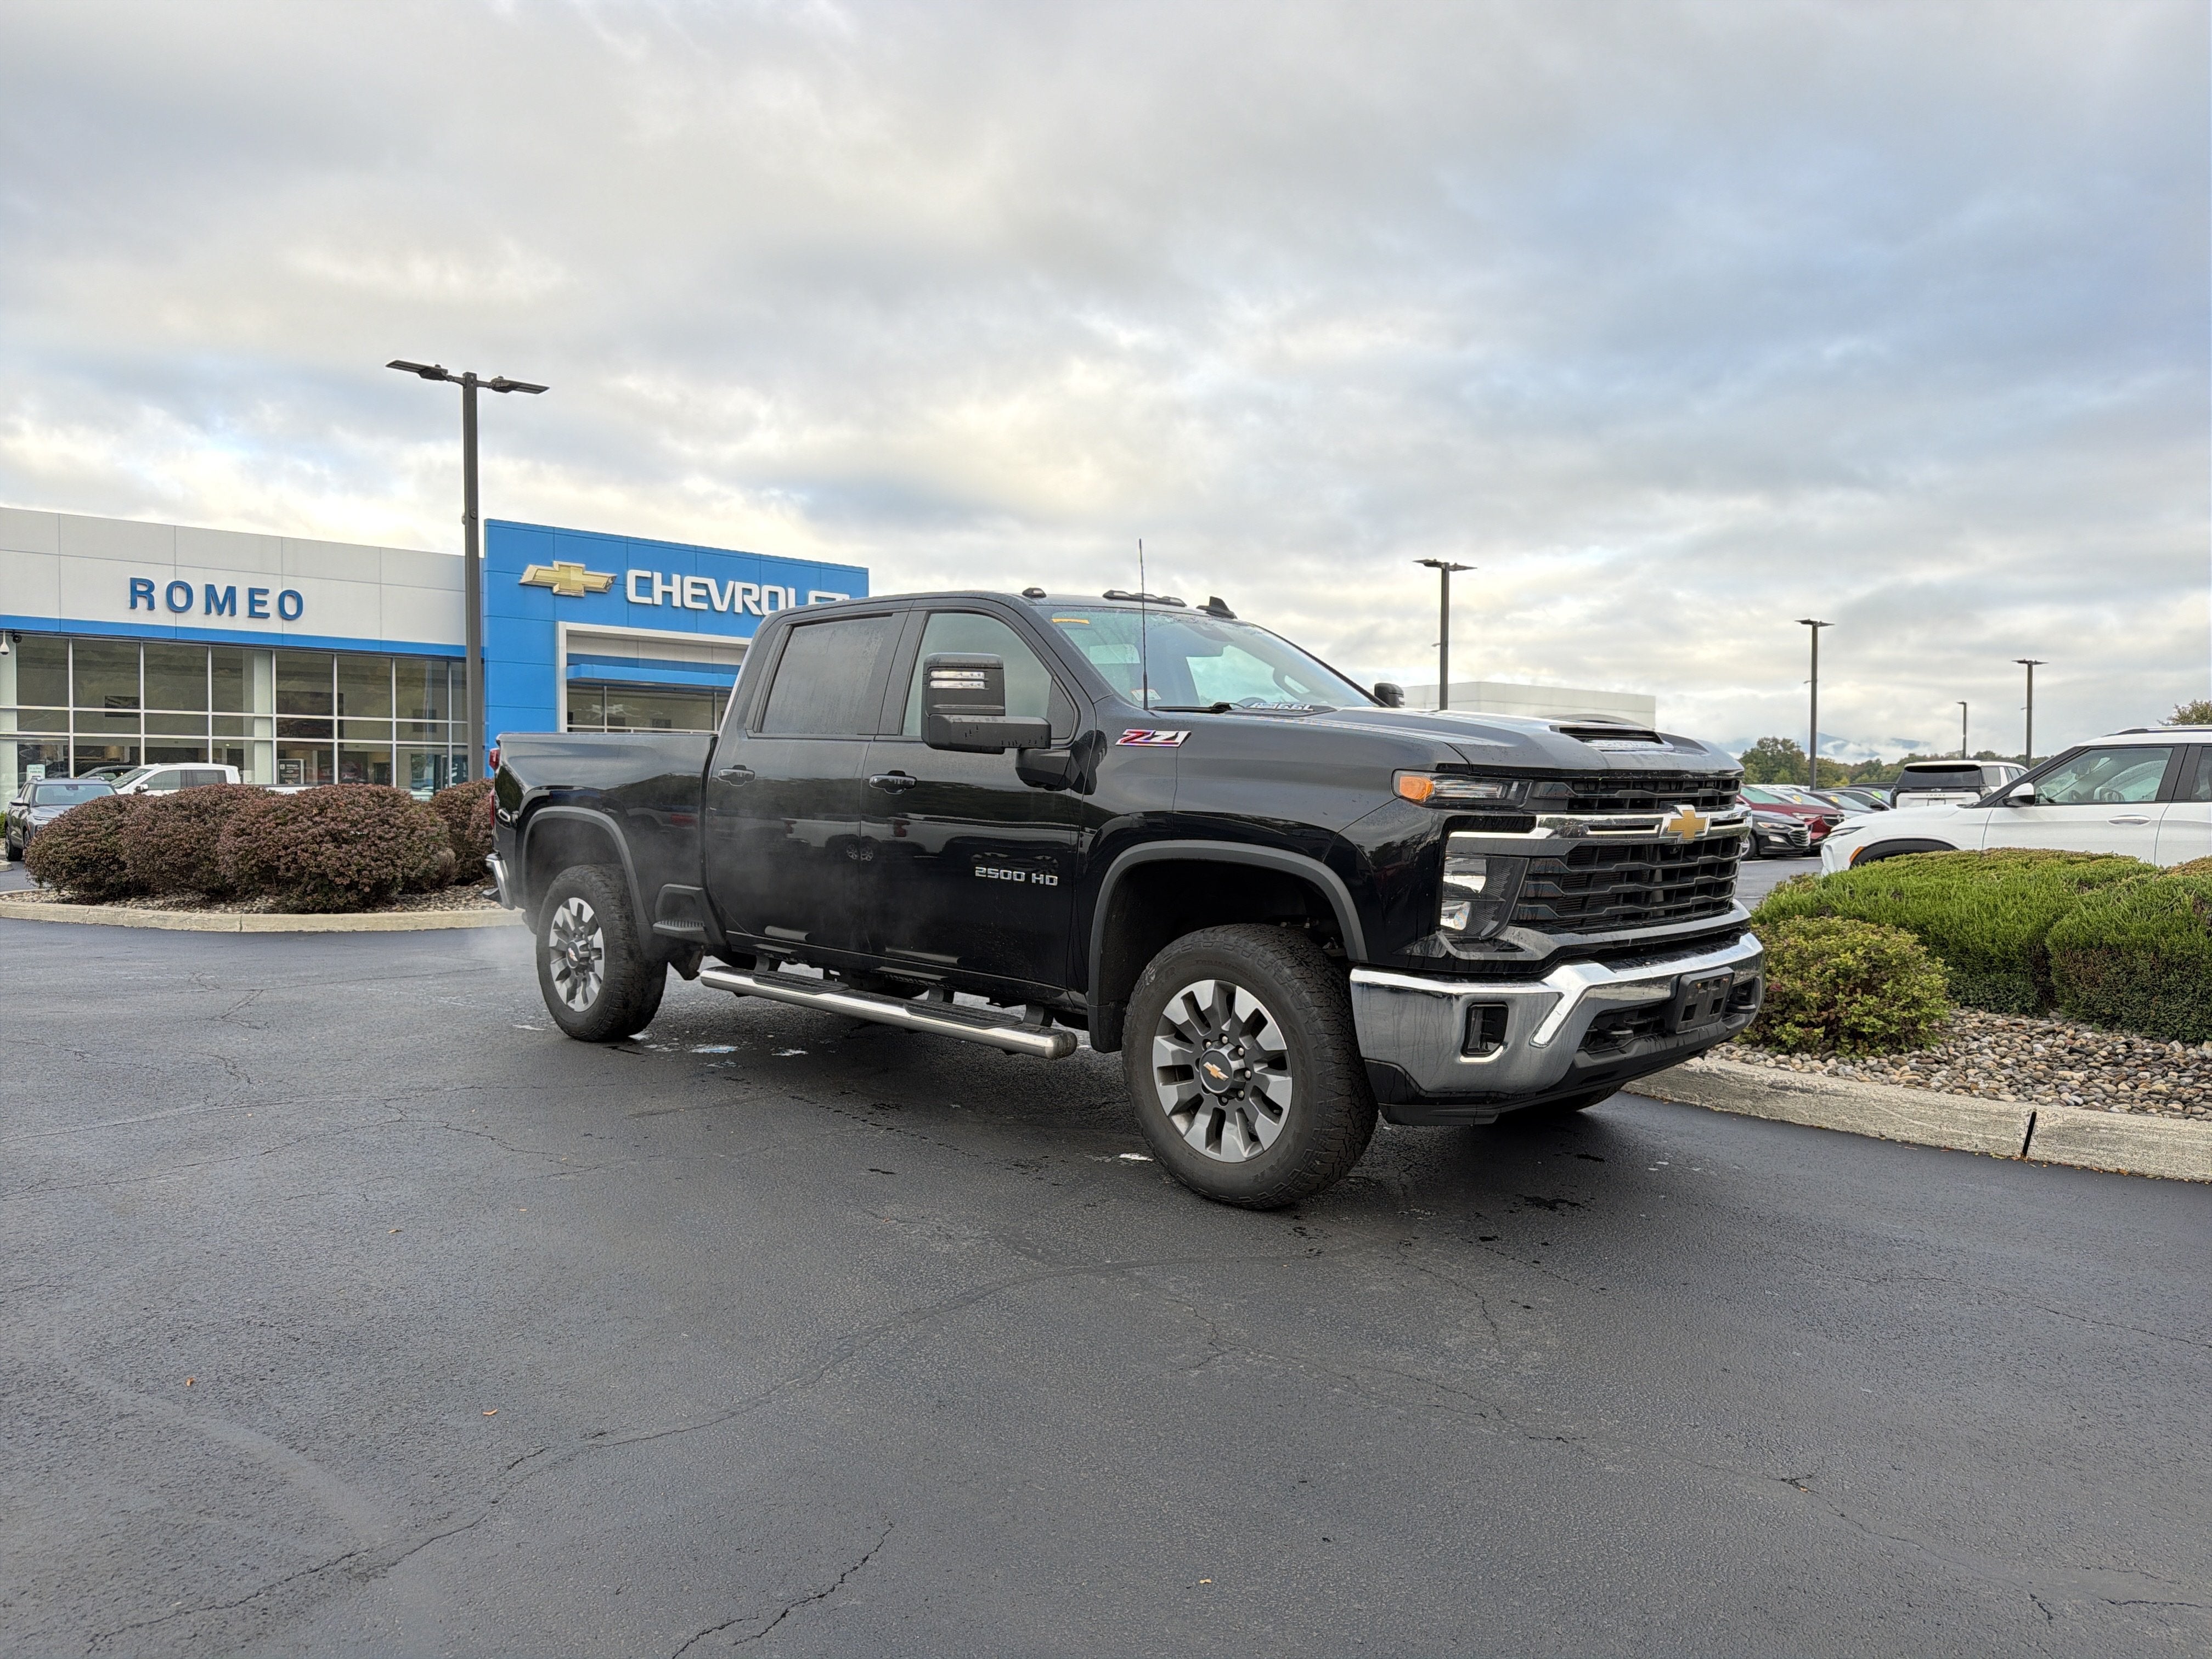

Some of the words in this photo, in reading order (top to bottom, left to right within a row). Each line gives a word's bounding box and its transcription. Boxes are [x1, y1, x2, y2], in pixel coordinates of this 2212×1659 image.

[129, 577, 304, 620] ROMEO
[626, 569, 850, 616] CHEVRO
[975, 866, 1026, 882] 2500
[1031, 873, 1058, 887] HD
